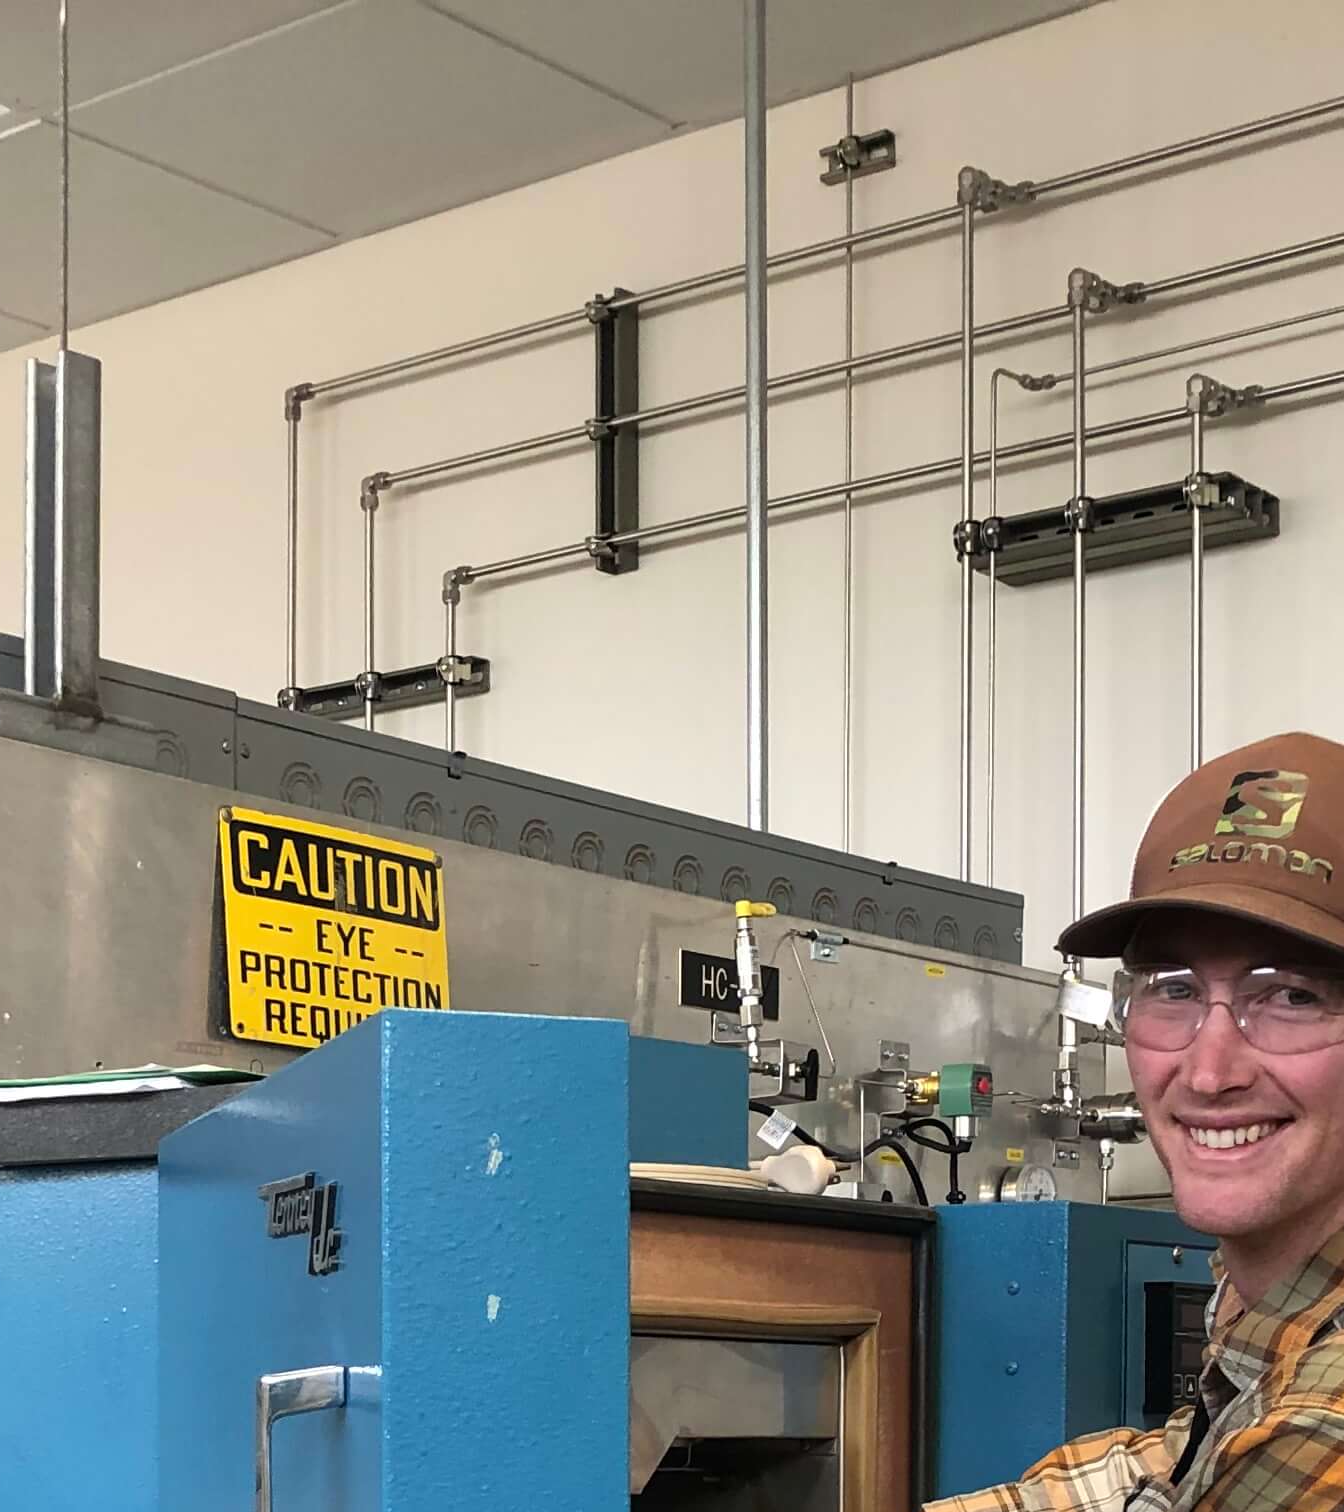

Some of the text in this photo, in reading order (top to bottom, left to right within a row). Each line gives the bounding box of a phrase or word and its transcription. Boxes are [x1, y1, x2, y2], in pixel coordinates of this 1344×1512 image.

[237, 830, 434, 922] CAUTION
[315, 918, 375, 962] EYE
[239, 950, 442, 1012] PROTECTION
